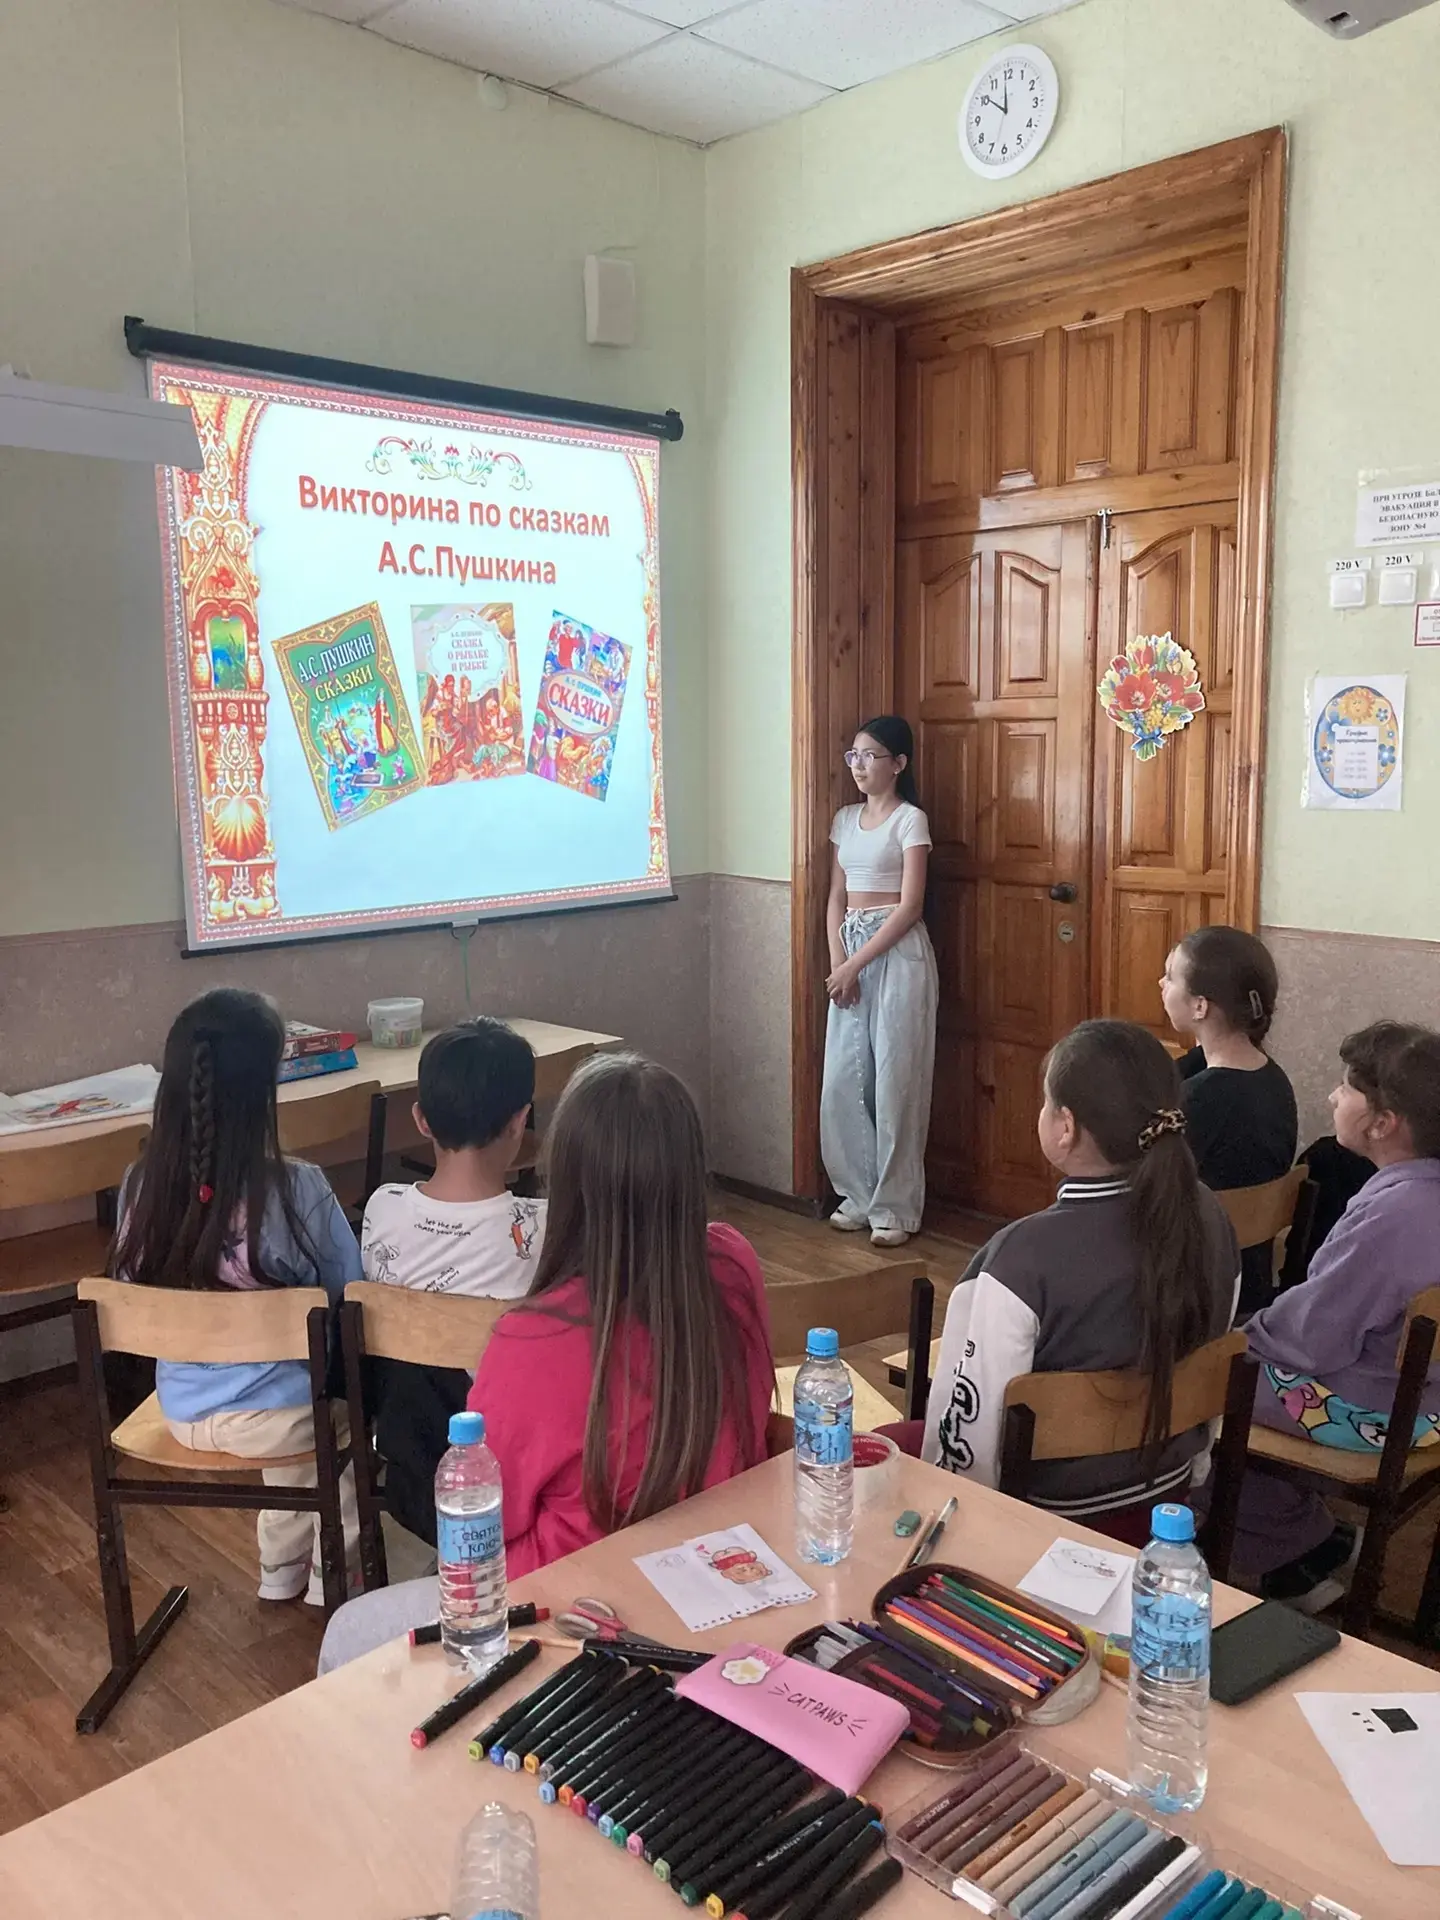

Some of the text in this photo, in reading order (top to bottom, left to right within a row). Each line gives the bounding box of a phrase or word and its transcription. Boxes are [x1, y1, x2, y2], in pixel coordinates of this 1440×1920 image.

[1003, 68, 1013, 81] 12
[1020, 69, 1025, 81] 1
[990, 79, 998, 90] 11
[1029, 79, 1036, 91] 2
[980, 95, 989, 106] 10
[1032, 97, 1039, 108] 3
[974, 115, 981, 126] 9
[1026, 117, 1033, 129] 4
[978, 132, 985, 144] 8
[1016, 134, 1022, 145] 5
[988, 142, 995, 154] 7
[1001, 144, 1008, 155] 6
[1373, 494, 1390, 503] ПРИ
[1392, 491, 1422, 500] УГРОЗЕ
[298, 475, 610, 537] Викторина по сказкам
[1381, 500, 1432, 512] ЭВАКУАЦИЯ
[1379, 511, 1439, 523] БЕЗОПАСНУЮ
[1389, 524, 1411, 533] ЗОНУ
[378, 541, 556, 587] А.С.Пушкина
[1335, 560, 1363, 571] 220 V
[1385, 554, 1414, 566] 220 V
[451, 638, 483, 648] СКАЗКА
[320, 633, 376, 673] ПУШКИН
[447, 649, 489, 660] О РЫБАКЕ
[315, 664, 374, 702] СКАЗКИ
[549, 683, 611, 727] СКАЗКИ
[462, 1523, 501, 1541] СВЯТО
[468, 1538, 501, 1556] КЛЮ
[787, 1693, 848, 1726] CATPAWS
